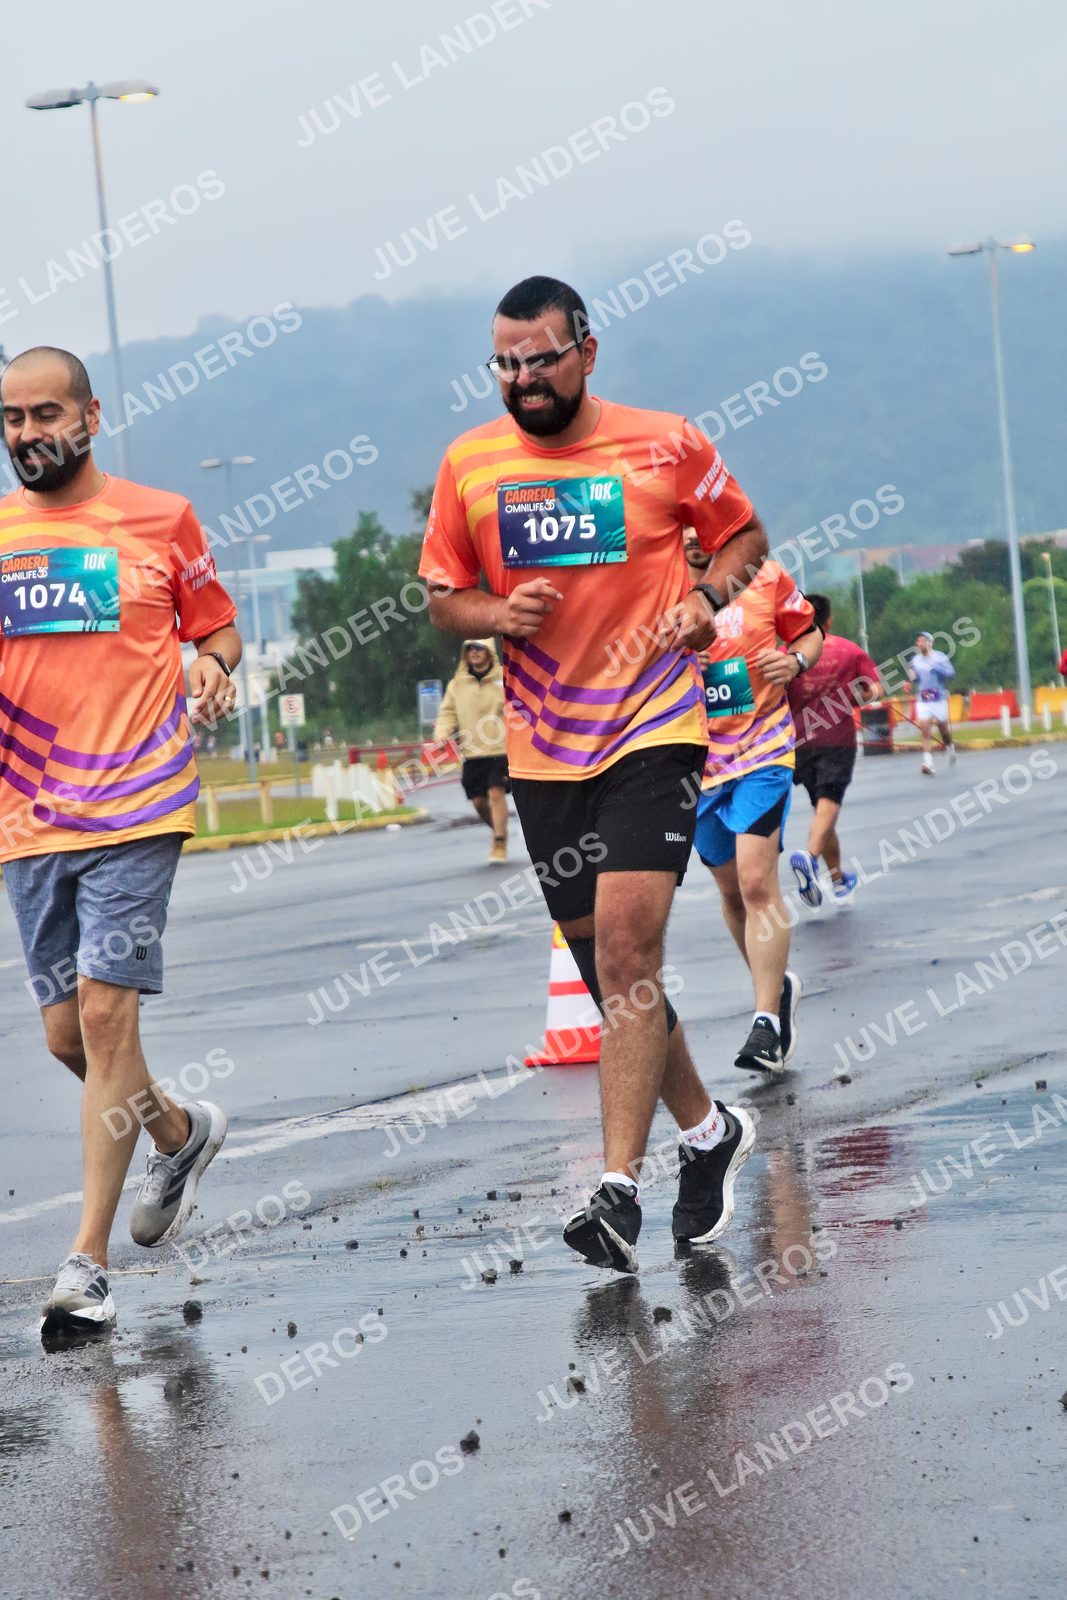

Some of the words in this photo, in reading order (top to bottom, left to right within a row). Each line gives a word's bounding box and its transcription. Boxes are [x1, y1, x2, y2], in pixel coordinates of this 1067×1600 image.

[505, 487, 556, 504] CARRERA
[589, 482, 613, 501] 10K
[523, 514, 596, 542] 1075
[2, 555, 48, 573] CARRERA
[83, 553, 107, 570] 10K
[14, 582, 86, 610] 1074
[724, 662, 740, 675] 10K
[705, 684, 732, 702] 90
